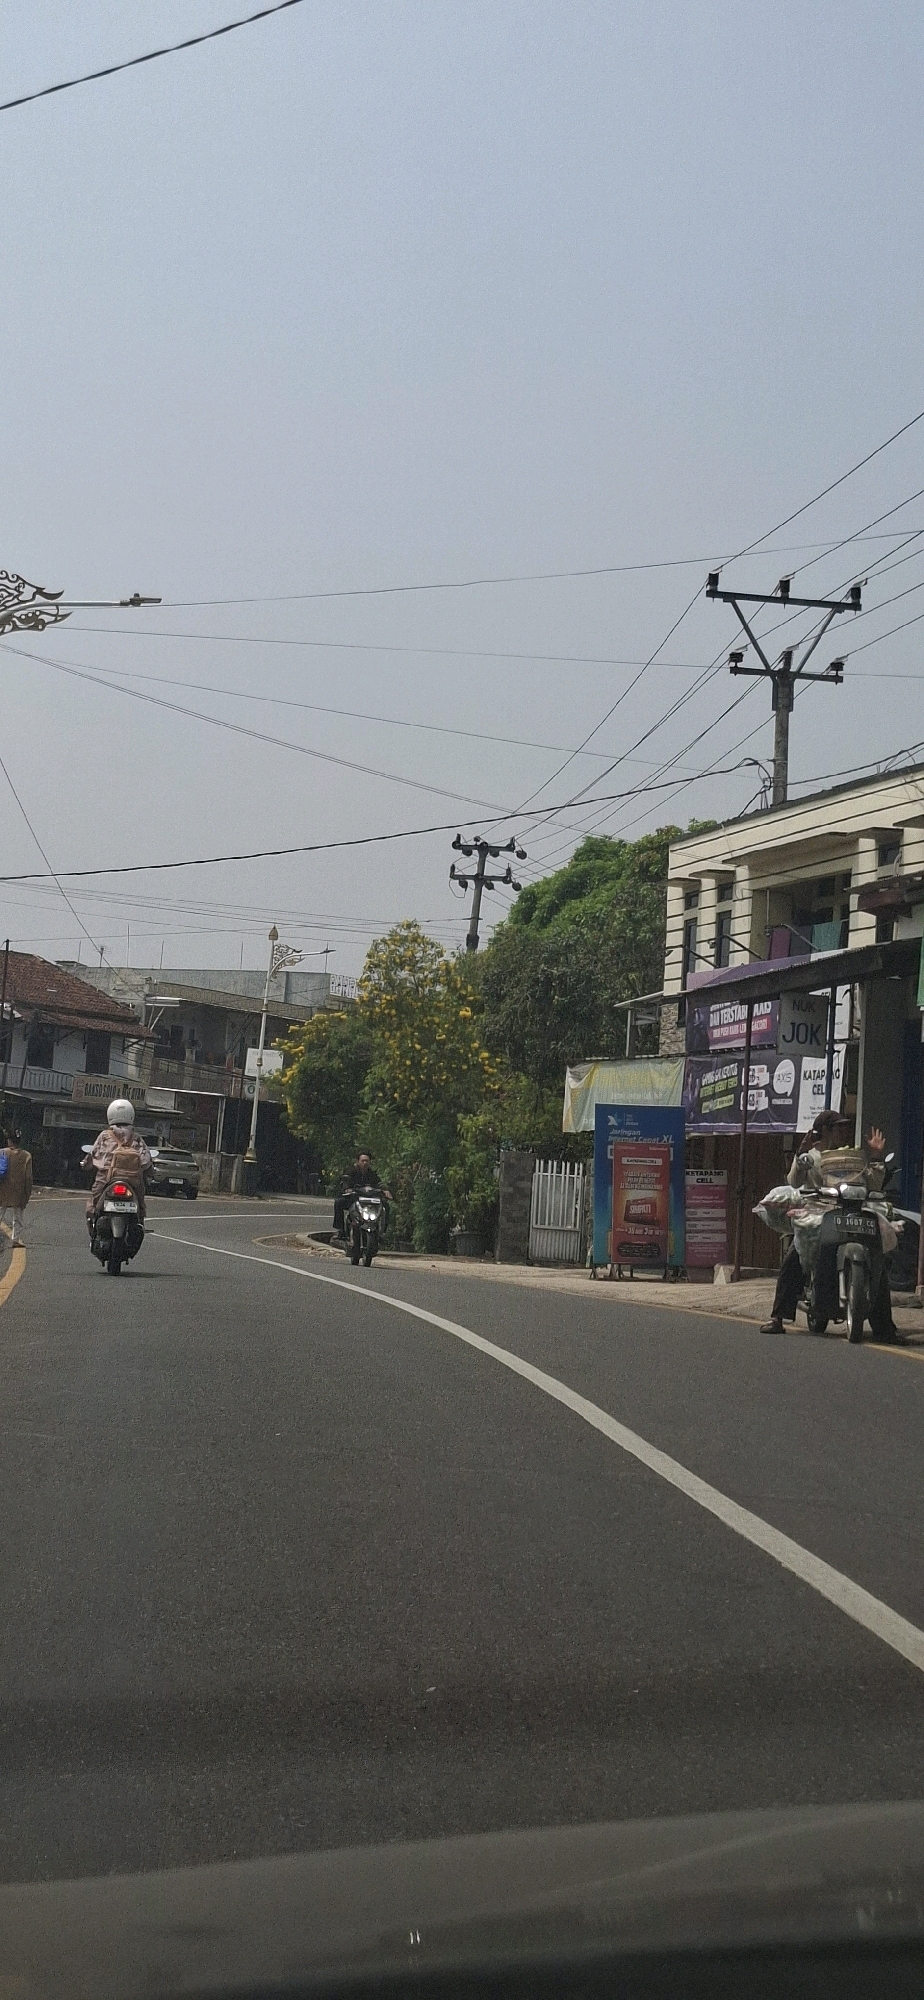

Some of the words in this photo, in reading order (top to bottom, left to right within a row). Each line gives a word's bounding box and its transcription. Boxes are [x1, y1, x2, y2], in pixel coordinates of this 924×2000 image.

[721, 1005, 748, 1025] TERSTABI
[782, 1022, 821, 1046] JOK
[776, 1073, 792, 1083] AXIS
[803, 1069, 840, 1080] KATAPG
[103, 1084, 116, 1099] SOLO
[812, 1084, 825, 1096] CEL
[661, 1135, 675, 1144] XL
